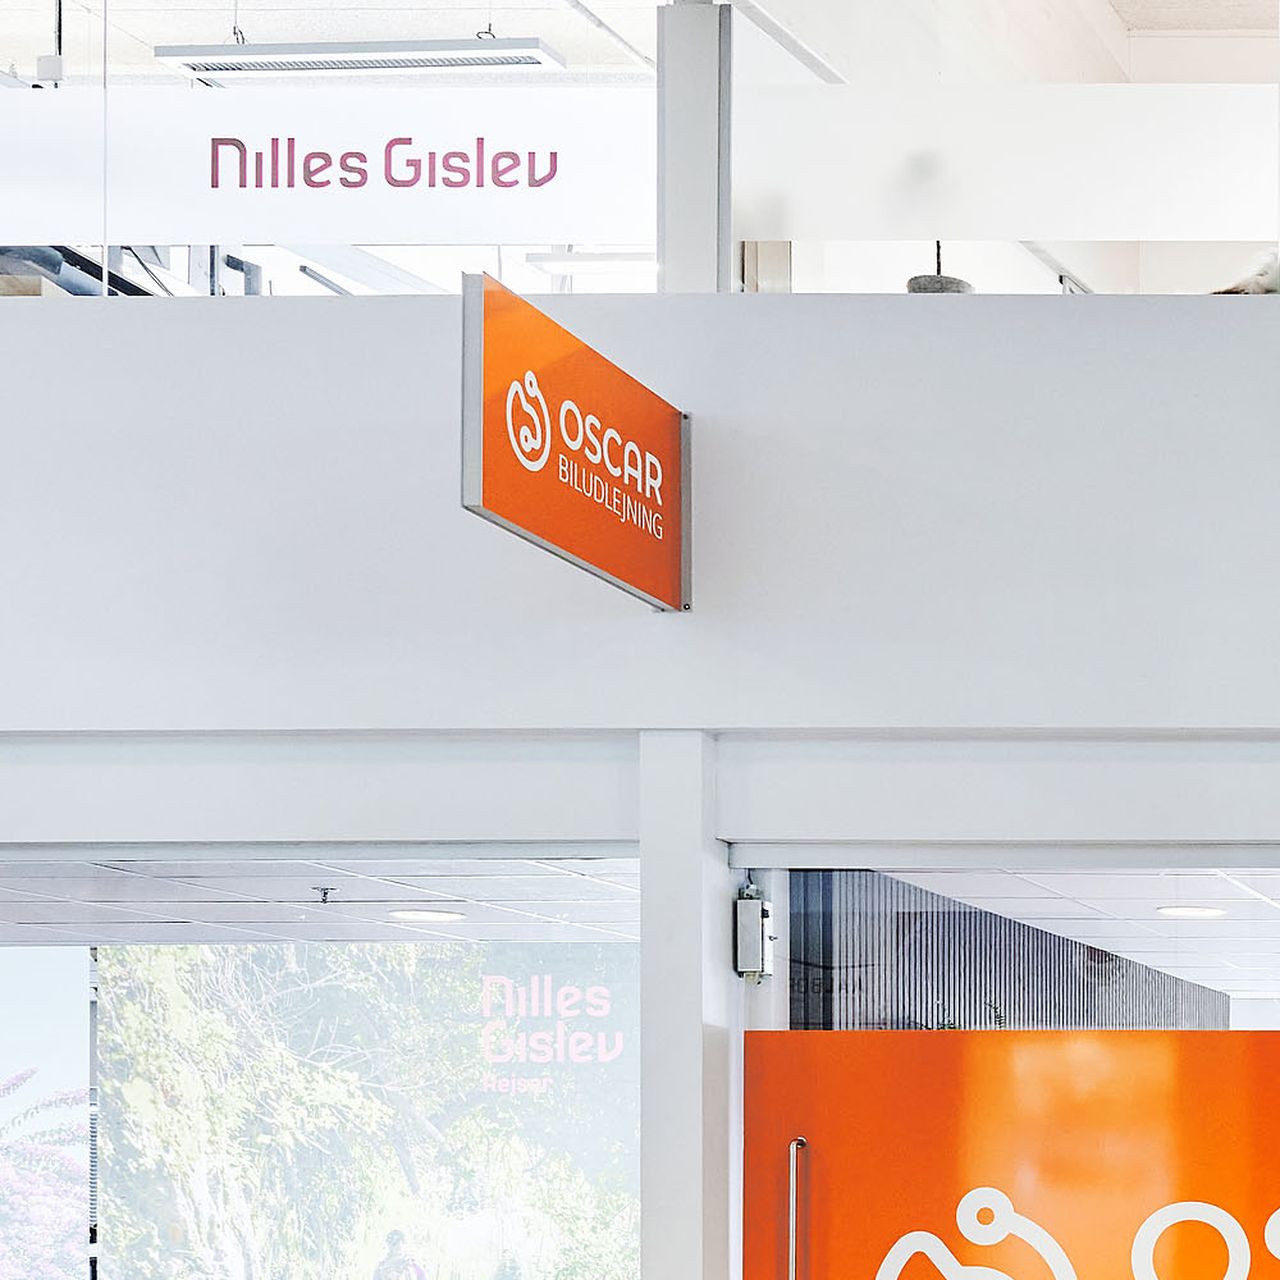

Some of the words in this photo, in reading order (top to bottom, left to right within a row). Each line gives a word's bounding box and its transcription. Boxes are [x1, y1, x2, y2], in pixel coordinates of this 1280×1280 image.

[384, 138, 557, 188] Gislev
[559, 400, 663, 506] OSCAR
[558, 454, 663, 540] BILUDLEJNING
